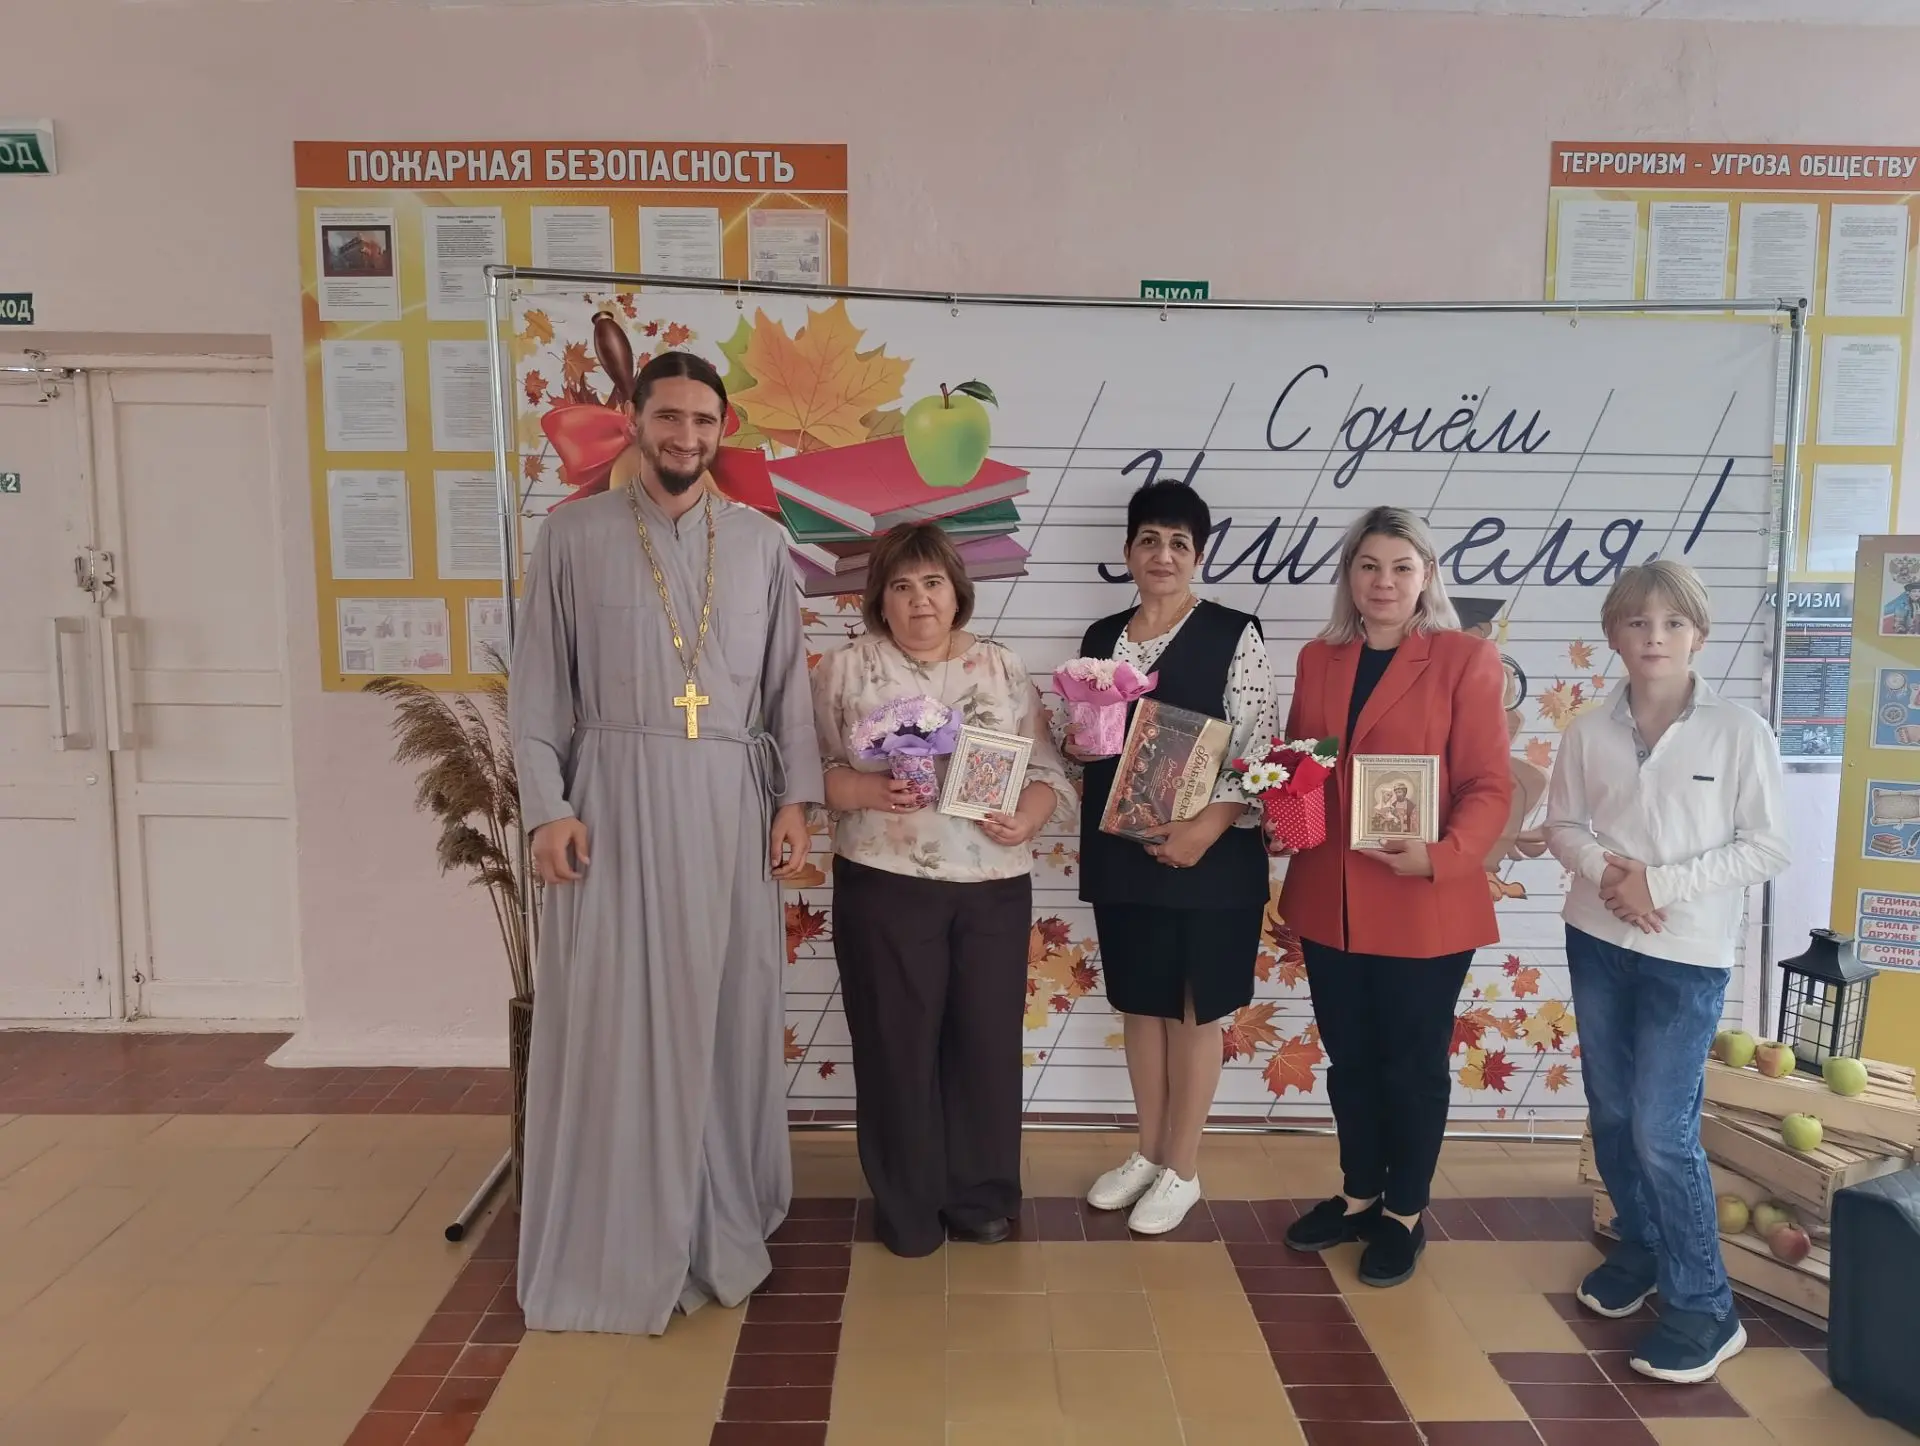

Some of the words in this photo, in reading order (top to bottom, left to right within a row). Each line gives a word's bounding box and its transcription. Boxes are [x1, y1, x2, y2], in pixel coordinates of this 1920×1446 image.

[347, 149, 533, 182] ПОЖАРНАЯ
[545, 149, 795, 183] БЕЗОПАСНОСТЬ
[1559, 152, 1687, 174] ТЕРРОРИЗМ
[1710, 153, 1791, 176] УГРОЗА
[1800, 154, 1918, 180] ОБЩЕСТВУ
[1266, 363, 1329, 451] С
[1332, 394, 1551, 489] днём
[5, 474, 17, 491] 2
[1875, 921, 1909, 931] СИЛА
[1868, 930, 1917, 941] ДРУЖБЕ
[1874, 945, 1915, 956] СОТНИ
[1880, 955, 1914, 967] ОДНО
